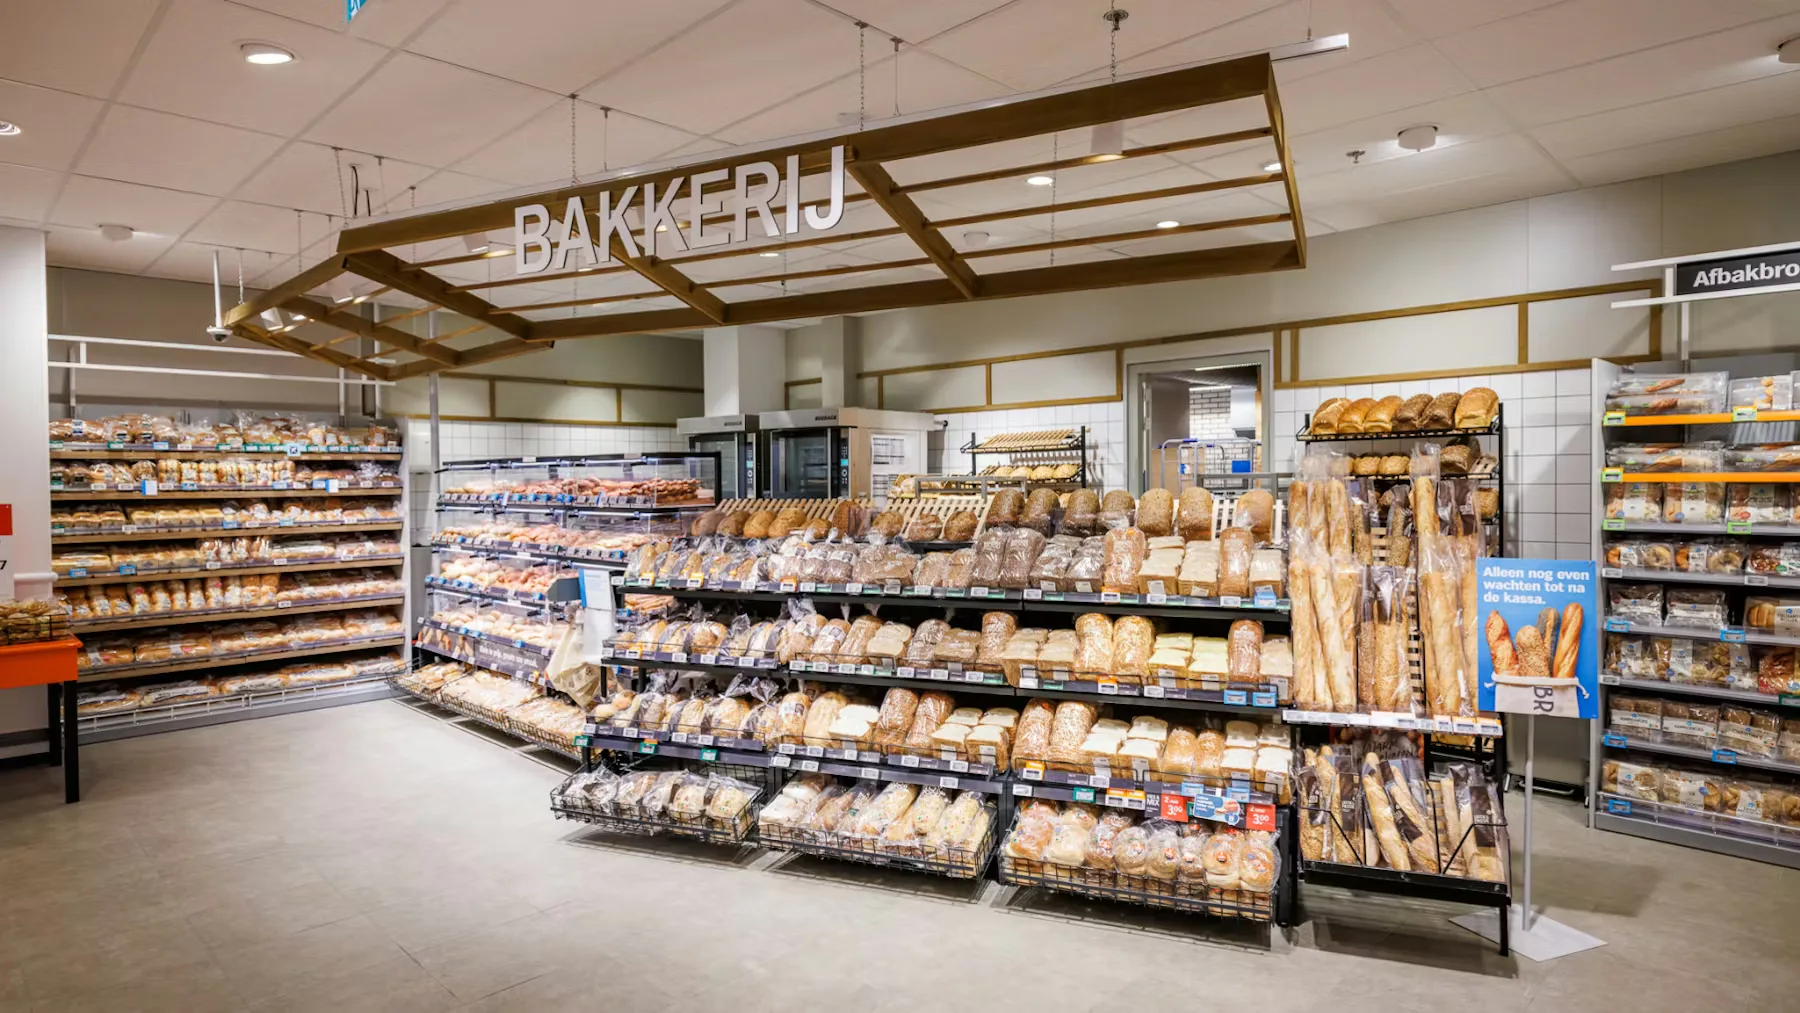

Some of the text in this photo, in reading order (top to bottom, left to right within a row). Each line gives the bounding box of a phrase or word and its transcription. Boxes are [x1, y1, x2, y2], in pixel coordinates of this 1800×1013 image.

[514, 145, 845, 276] BAKKERIJ
[1483, 566, 1589, 581] Alleen nog even
[1483, 579, 1586, 594] wachten tot na
[1483, 590, 1547, 605] de kassa.
